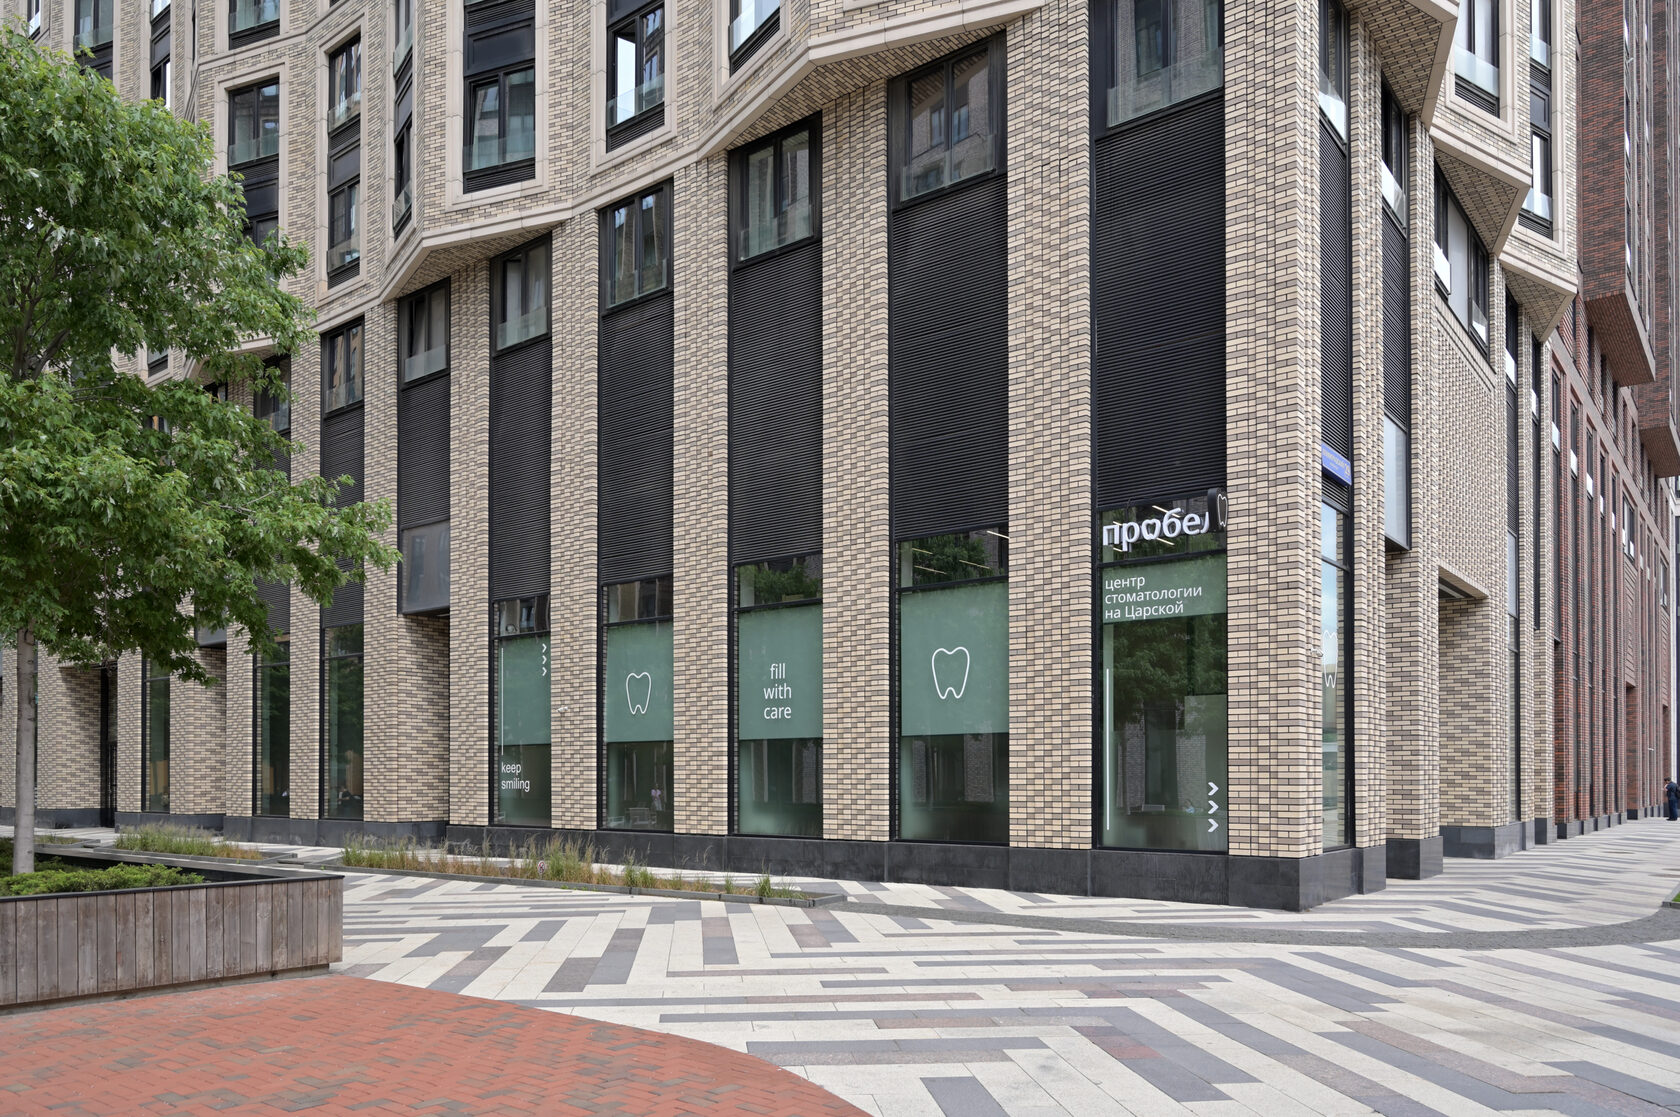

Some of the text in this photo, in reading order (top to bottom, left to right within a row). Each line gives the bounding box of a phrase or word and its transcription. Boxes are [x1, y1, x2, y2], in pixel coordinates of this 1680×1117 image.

[1105, 576, 1146, 591] центр
[1105, 586, 1202, 604] стоматологии
[1105, 601, 1184, 619] на Царской
[770, 662, 786, 680] fill
[763, 683, 792, 700] with
[764, 706, 792, 720] care
[501, 762, 522, 776] keep
[501, 778, 530, 793] smiling
